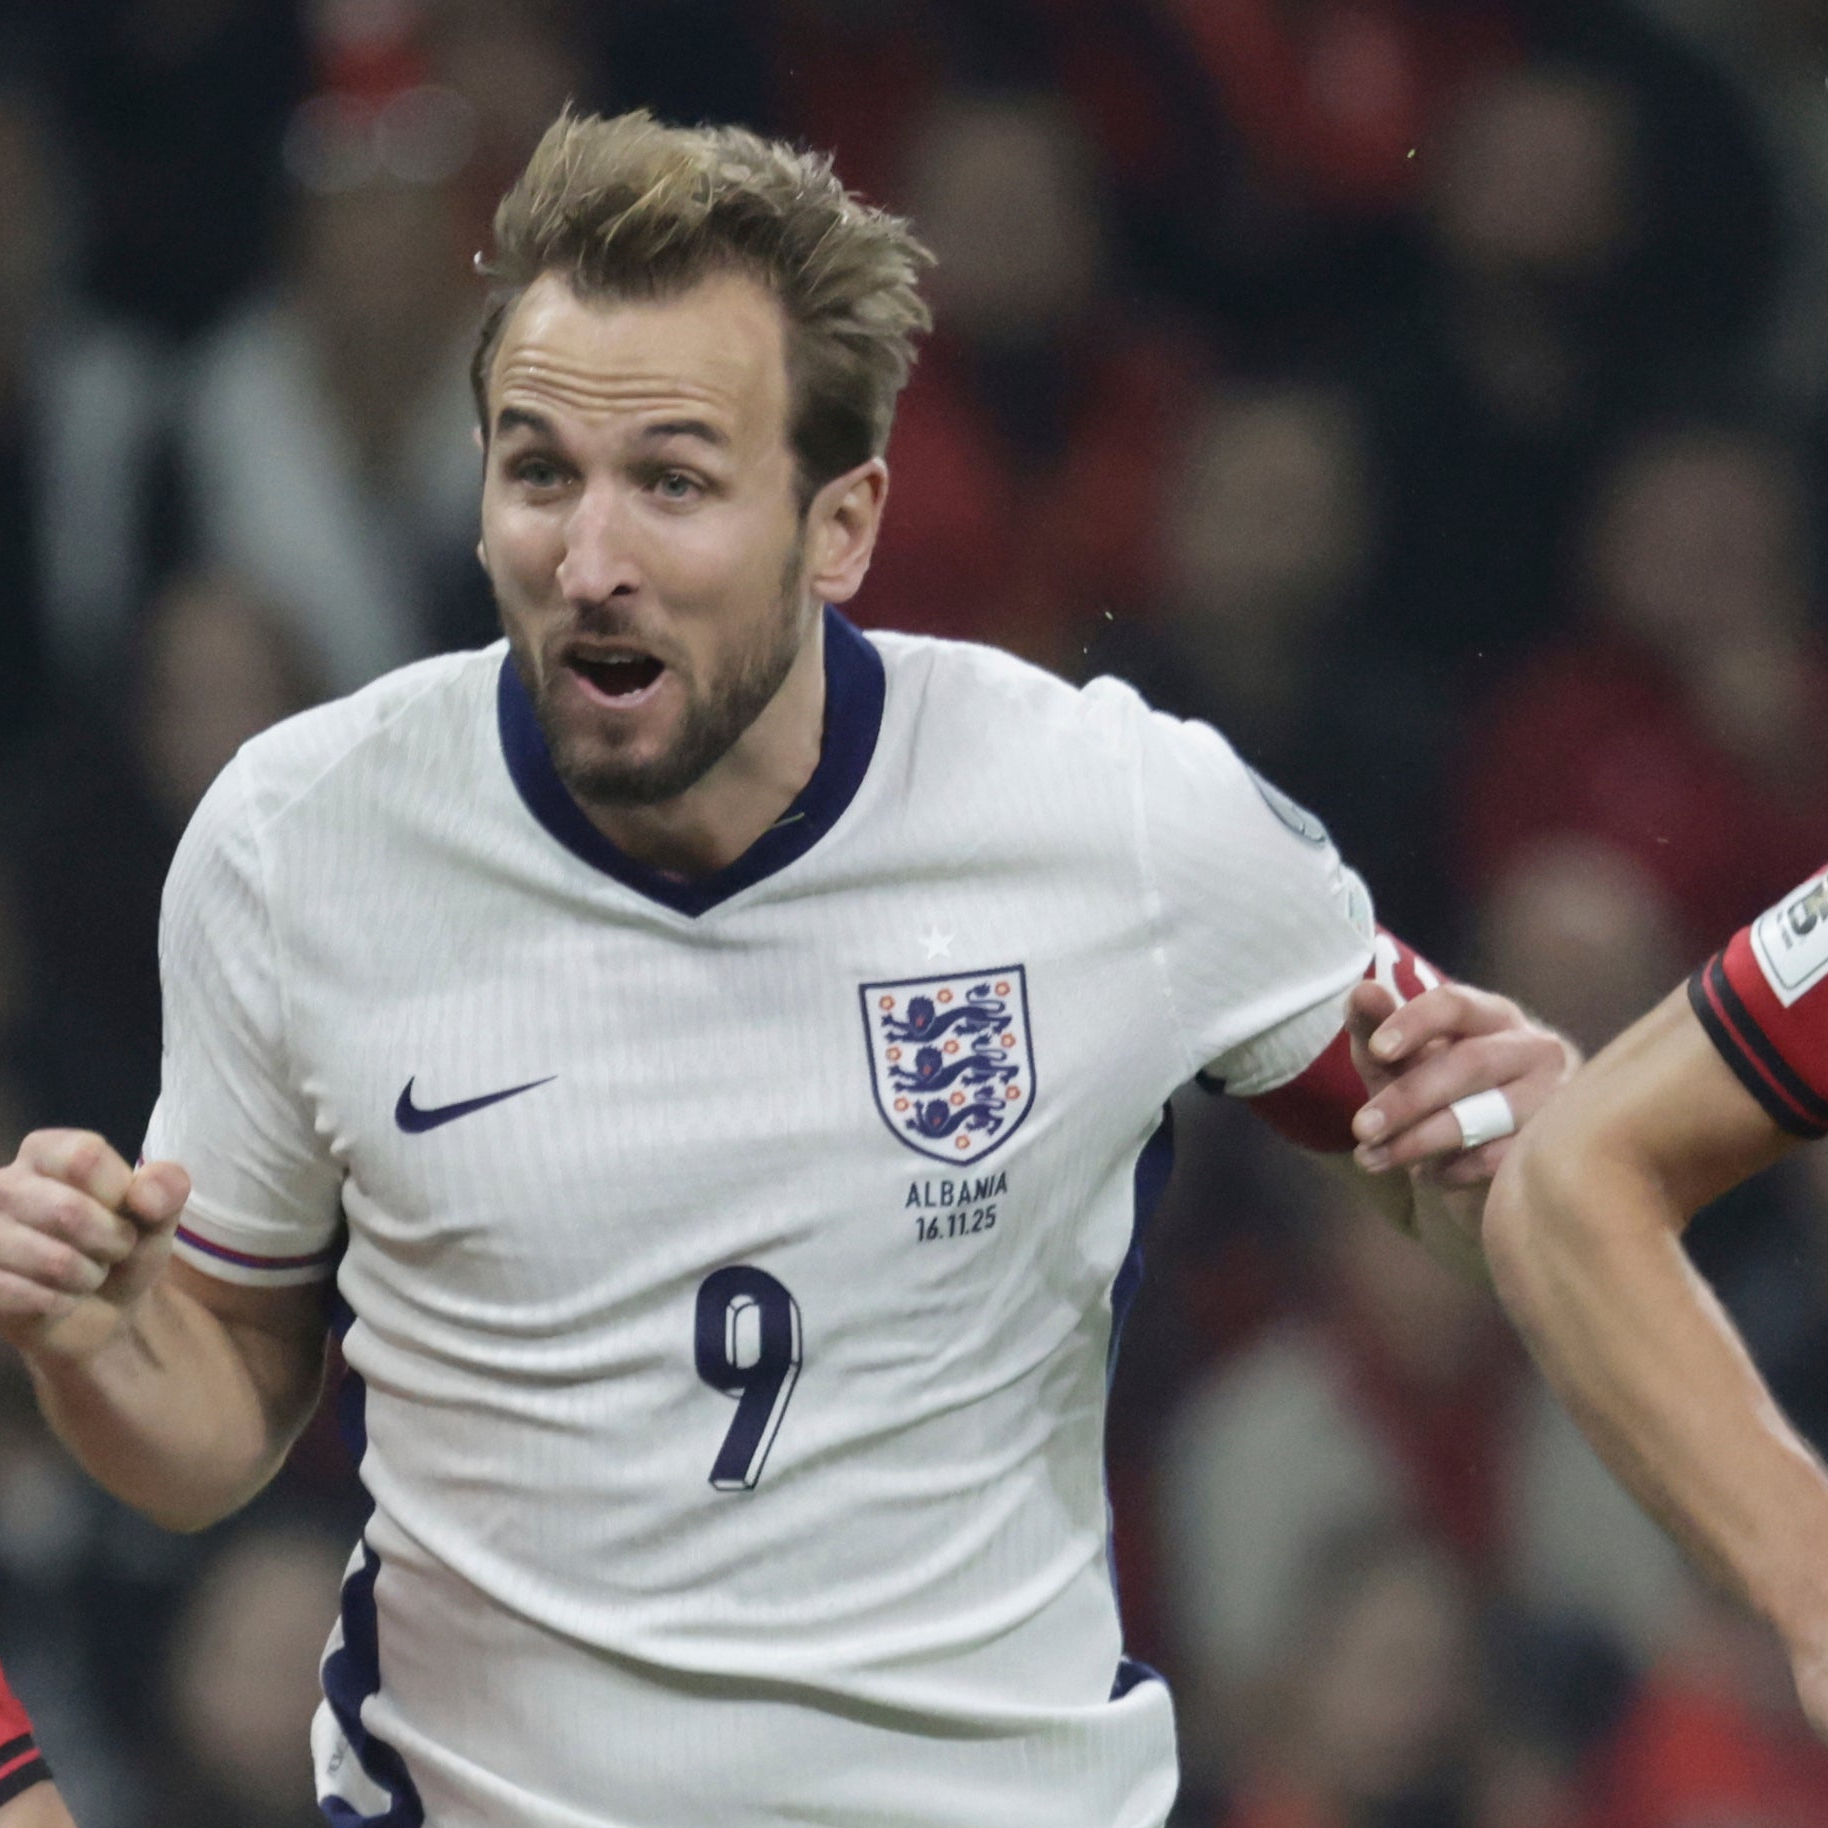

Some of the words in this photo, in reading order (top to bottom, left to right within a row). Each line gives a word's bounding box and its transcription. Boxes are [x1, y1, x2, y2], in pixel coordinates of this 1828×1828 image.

[904, 1170, 1008, 1209] ALBANIA
[915, 1203, 998, 1242] 16.11.25
[694, 1265, 804, 1492] 9
